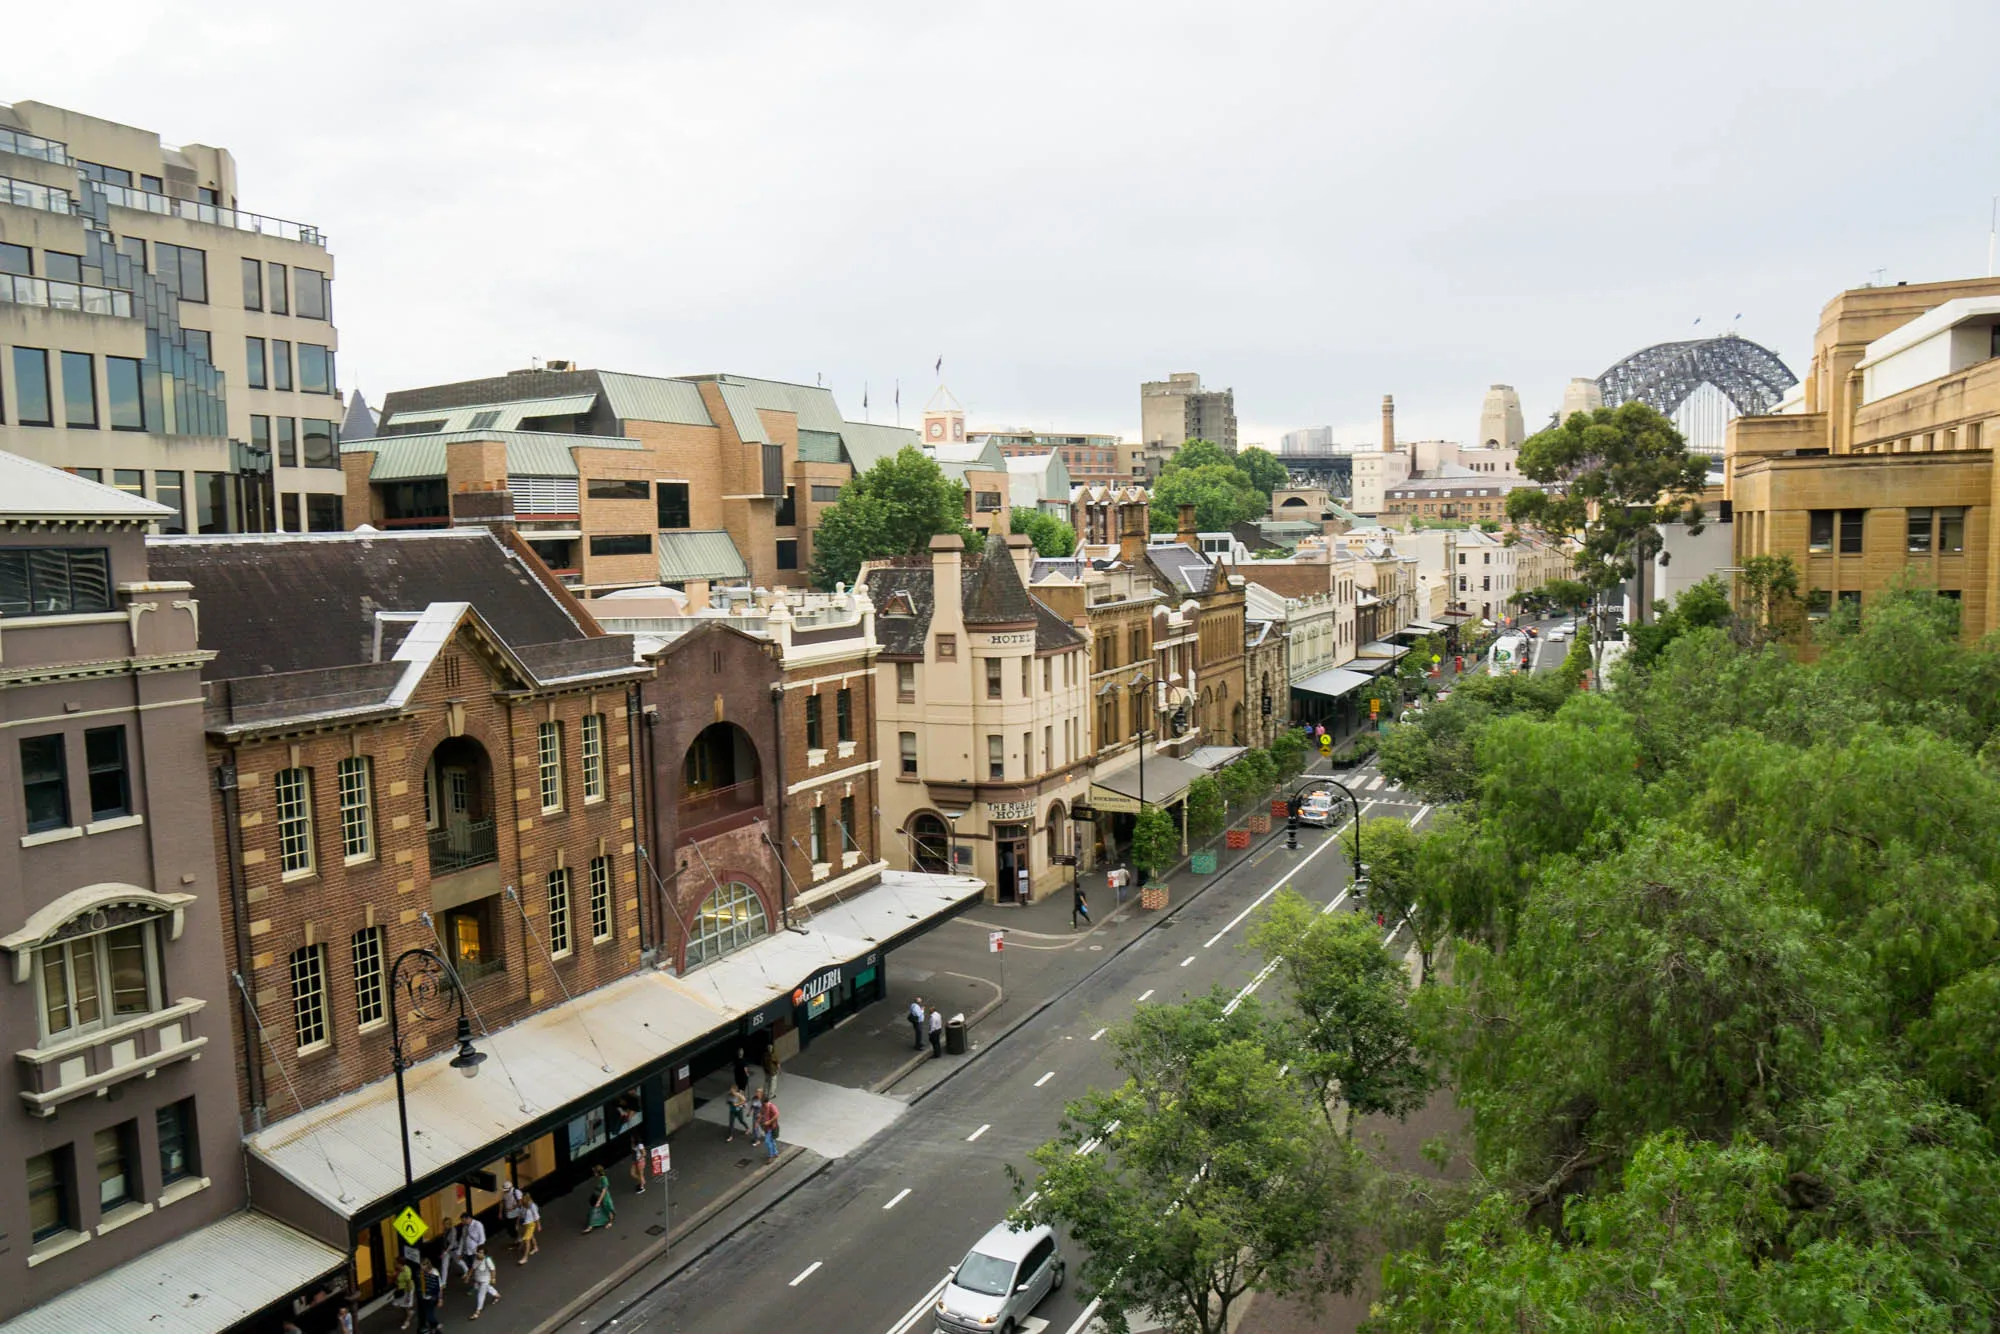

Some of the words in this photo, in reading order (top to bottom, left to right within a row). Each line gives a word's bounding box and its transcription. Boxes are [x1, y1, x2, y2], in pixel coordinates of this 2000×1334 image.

[991, 633, 1031, 644] HOTEL
[987, 802, 1006, 811] THE
[803, 968, 841, 1001] GALLERIA
